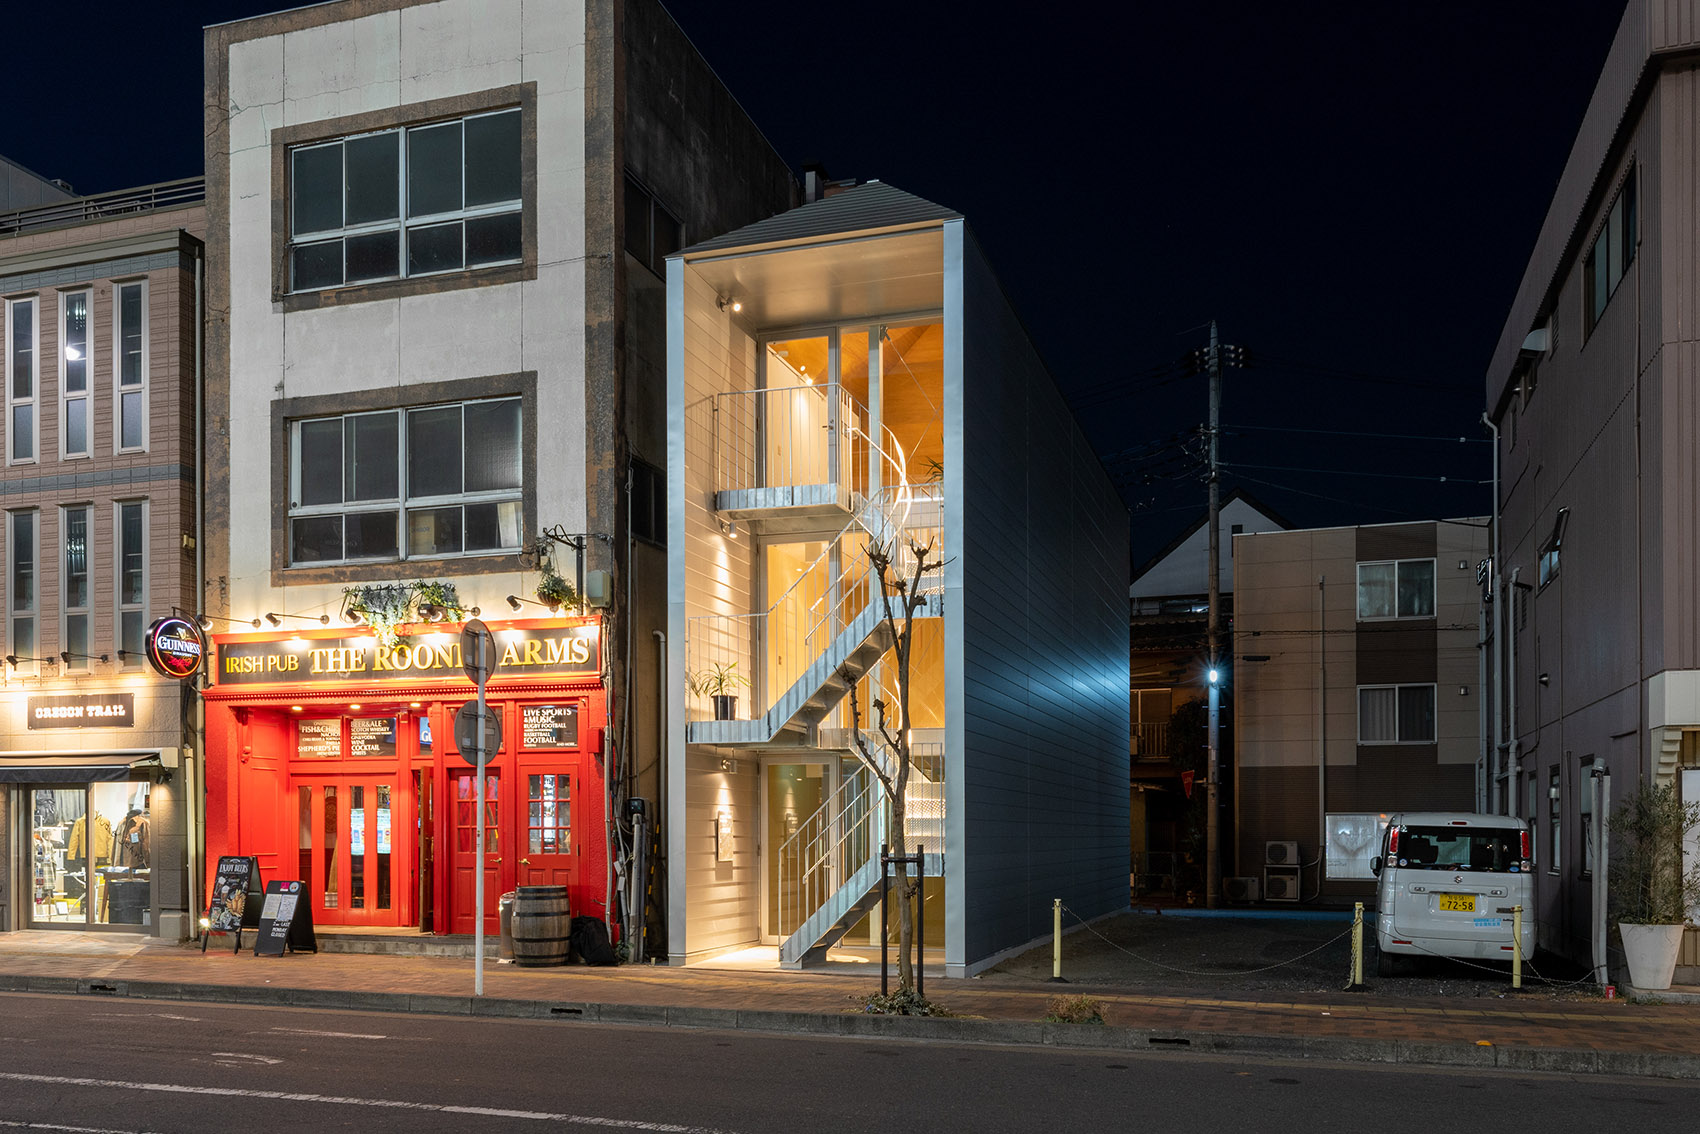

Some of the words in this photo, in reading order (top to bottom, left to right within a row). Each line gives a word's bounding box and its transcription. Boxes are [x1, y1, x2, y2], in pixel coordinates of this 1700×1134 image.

[158, 635, 201, 656] GUINNESS
[226, 656, 264, 673] IRISH
[267, 655, 299, 672] PUB
[308, 648, 366, 673] THE
[372, 642, 463, 671] ROON
[499, 637, 591, 667] ARMS
[35, 706, 84, 719] OREGON
[86, 704, 126, 717] TRAIL
[541, 708, 572, 716] SPORTS
[1447, 900, 1474, 911] 72-58
